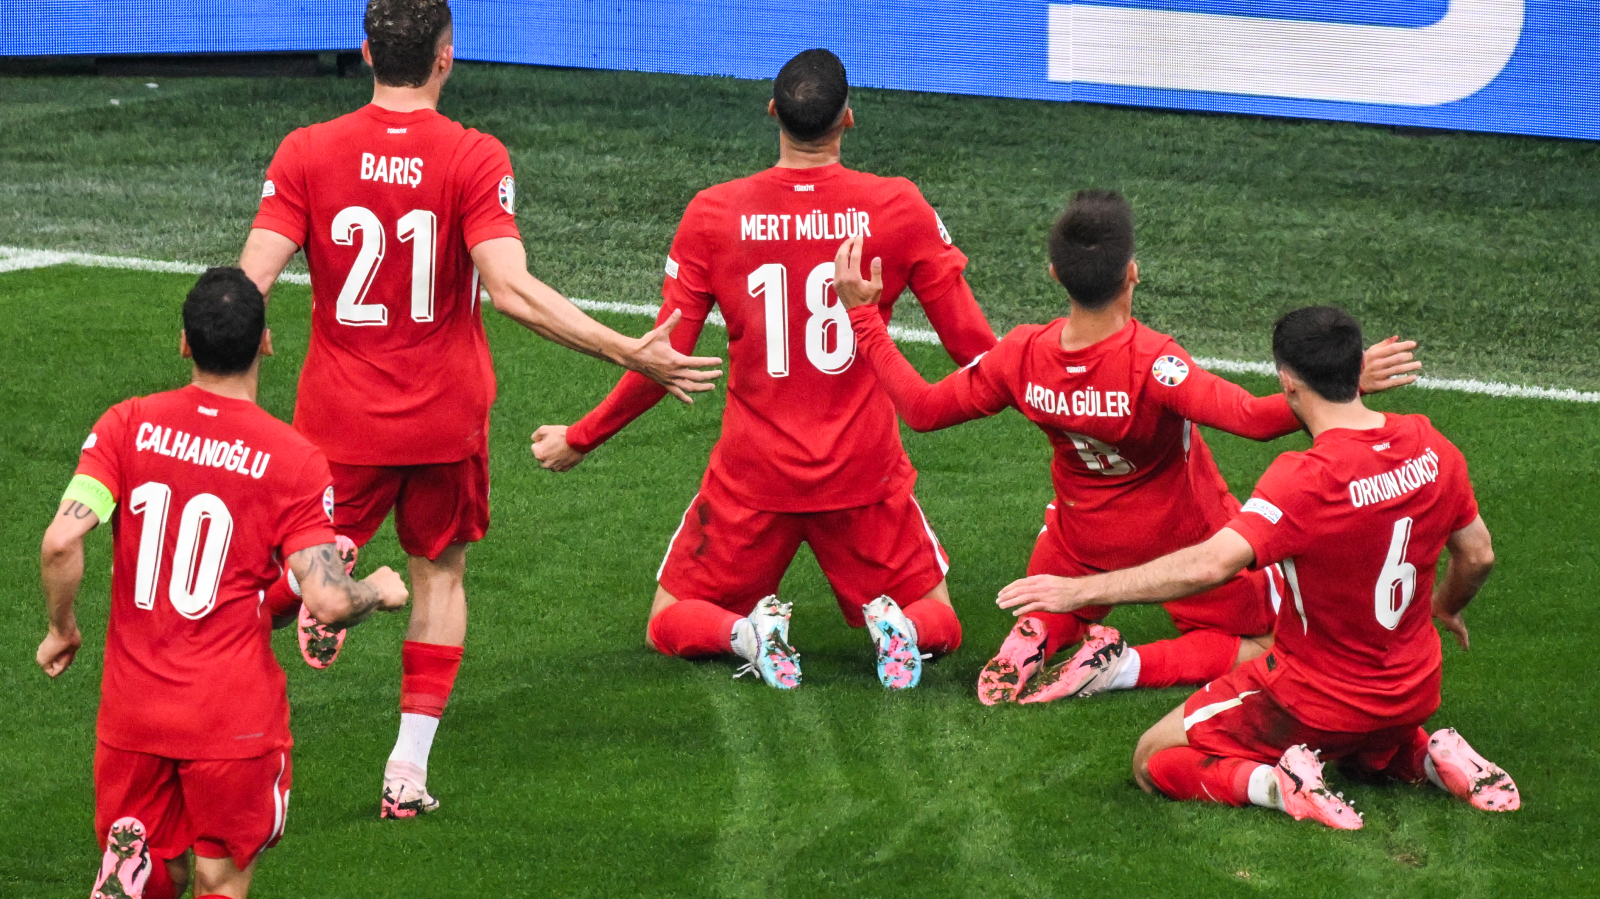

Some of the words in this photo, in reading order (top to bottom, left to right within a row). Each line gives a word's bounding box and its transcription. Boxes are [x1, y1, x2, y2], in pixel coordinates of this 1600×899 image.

[360, 152, 423, 188] BARIŞ
[740, 213, 791, 241] MERT
[796, 207, 872, 241] MÜLDÜR
[331, 205, 437, 327] 21
[747, 261, 857, 378] 18
[1025, 381, 1070, 416] ARDA
[1072, 386, 1131, 417] GÜLER
[135, 422, 271, 480] ÇALHANOĞLU
[1349, 470, 1402, 508] ORKUN
[129, 481, 234, 620] 10
[1374, 516, 1417, 630] 6
